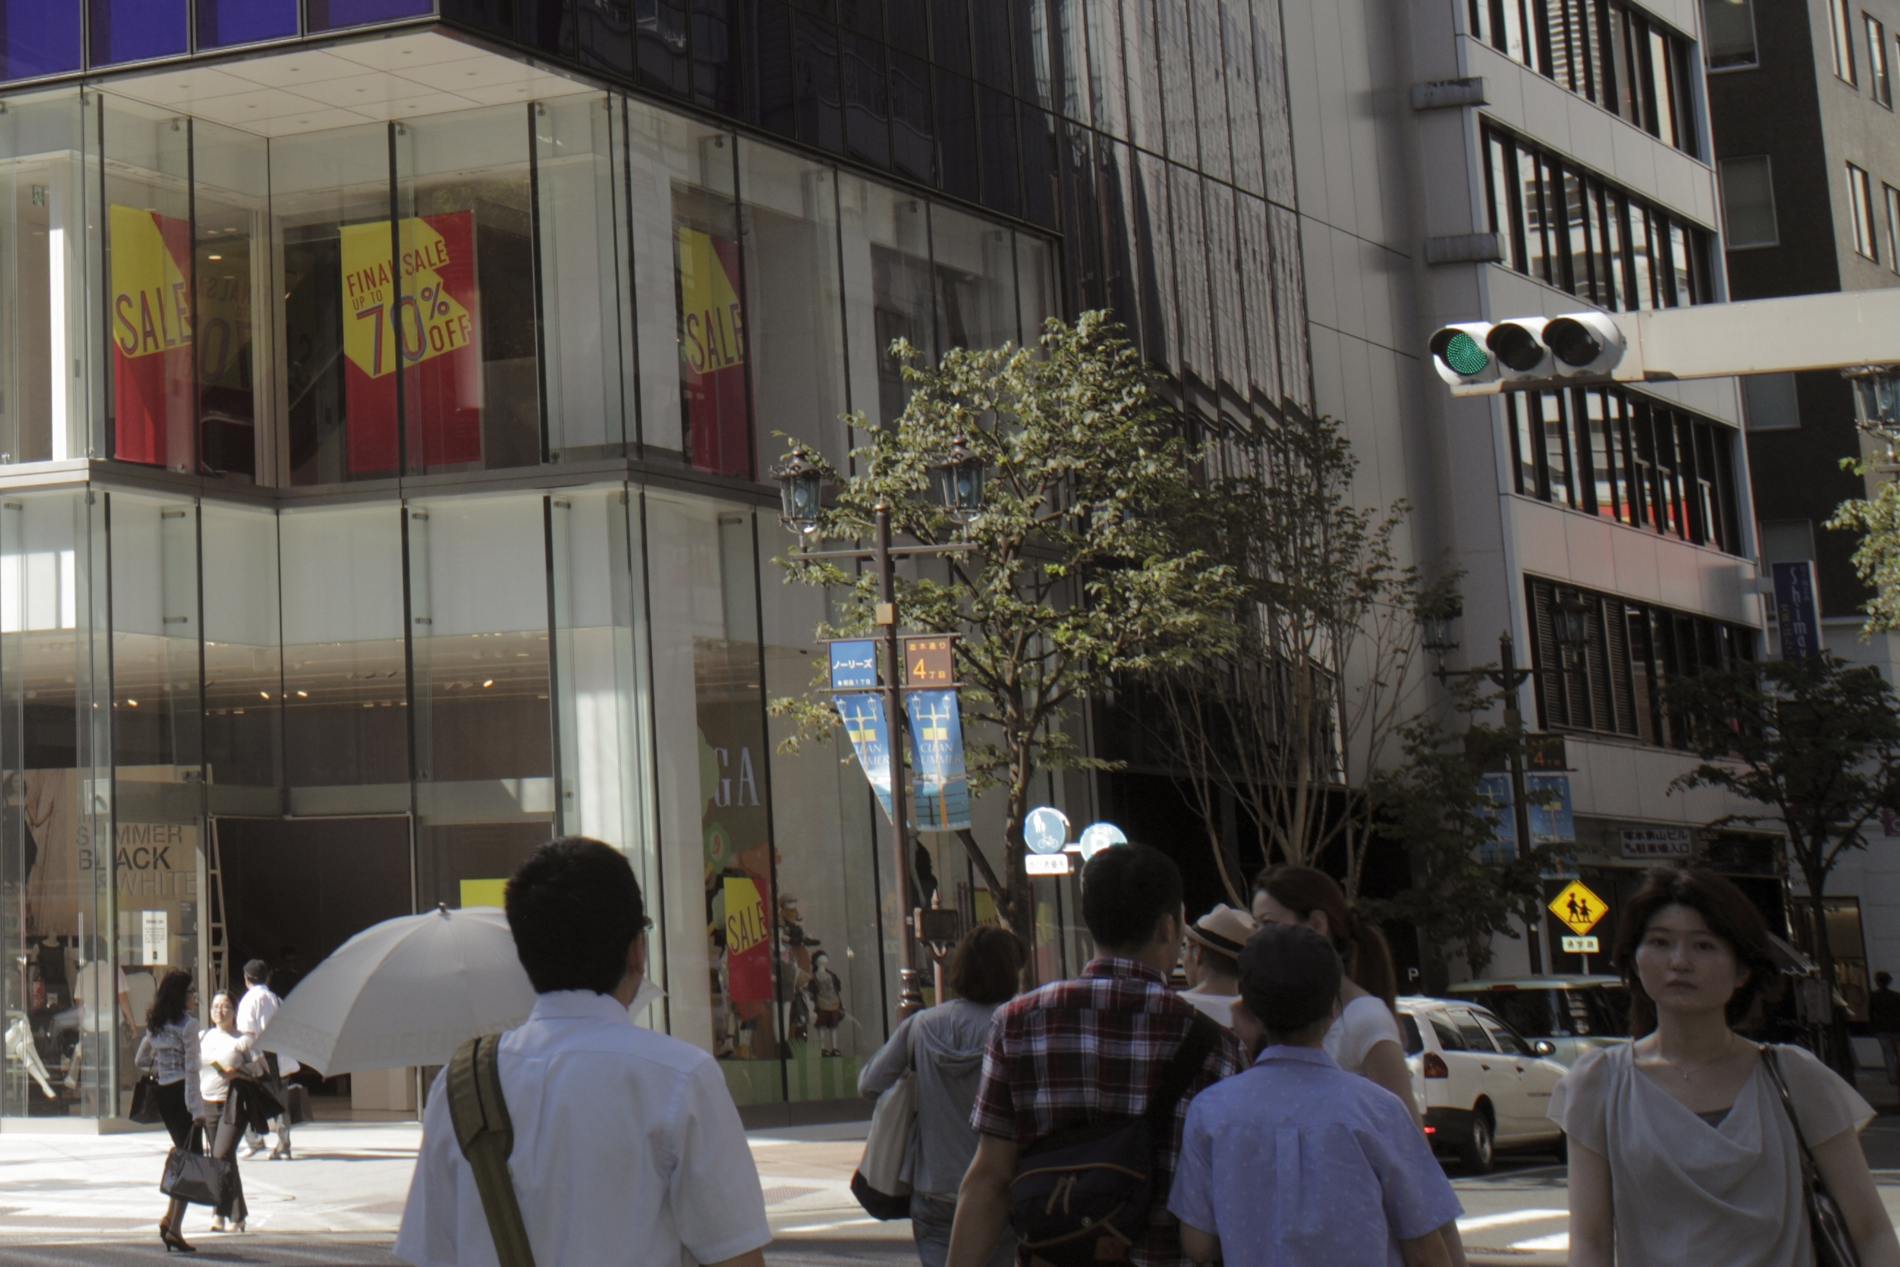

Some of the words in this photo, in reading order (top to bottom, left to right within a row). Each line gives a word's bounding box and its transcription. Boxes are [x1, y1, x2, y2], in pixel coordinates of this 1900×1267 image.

[403, 239, 447, 276] SALE
[115, 281, 193, 356] SALE
[352, 296, 365, 311] UP
[370, 290, 383, 304] TO
[428, 313, 470, 353] OFF
[686, 302, 743, 373] SALE
[833, 658, 873, 670] ノーリーズ
[912, 658, 946, 680] 4丁目
[78, 846, 171, 871] BLACK
[727, 899, 768, 956] SALE
